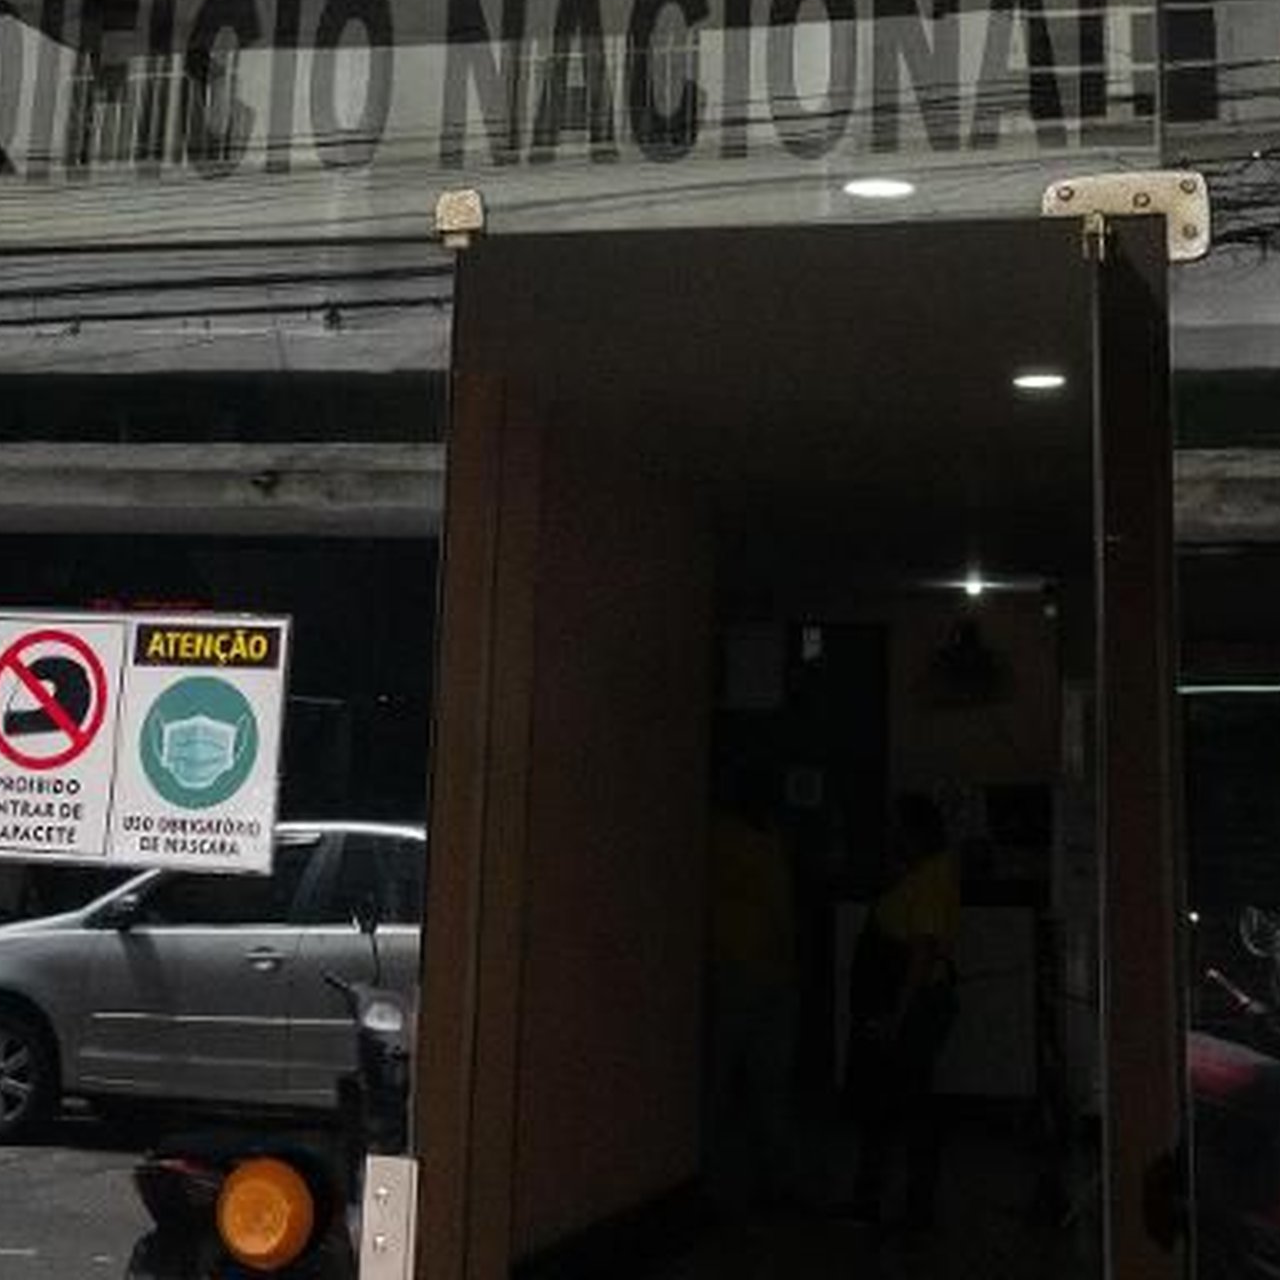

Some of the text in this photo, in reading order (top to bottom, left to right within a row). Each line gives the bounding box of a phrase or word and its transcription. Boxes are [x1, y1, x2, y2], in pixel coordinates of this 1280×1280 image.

[146, 629, 269, 665] ATENÇÃO
[59, 802, 84, 820] DE
[122, 815, 154, 832] USO
[139, 836, 159, 852] DE
